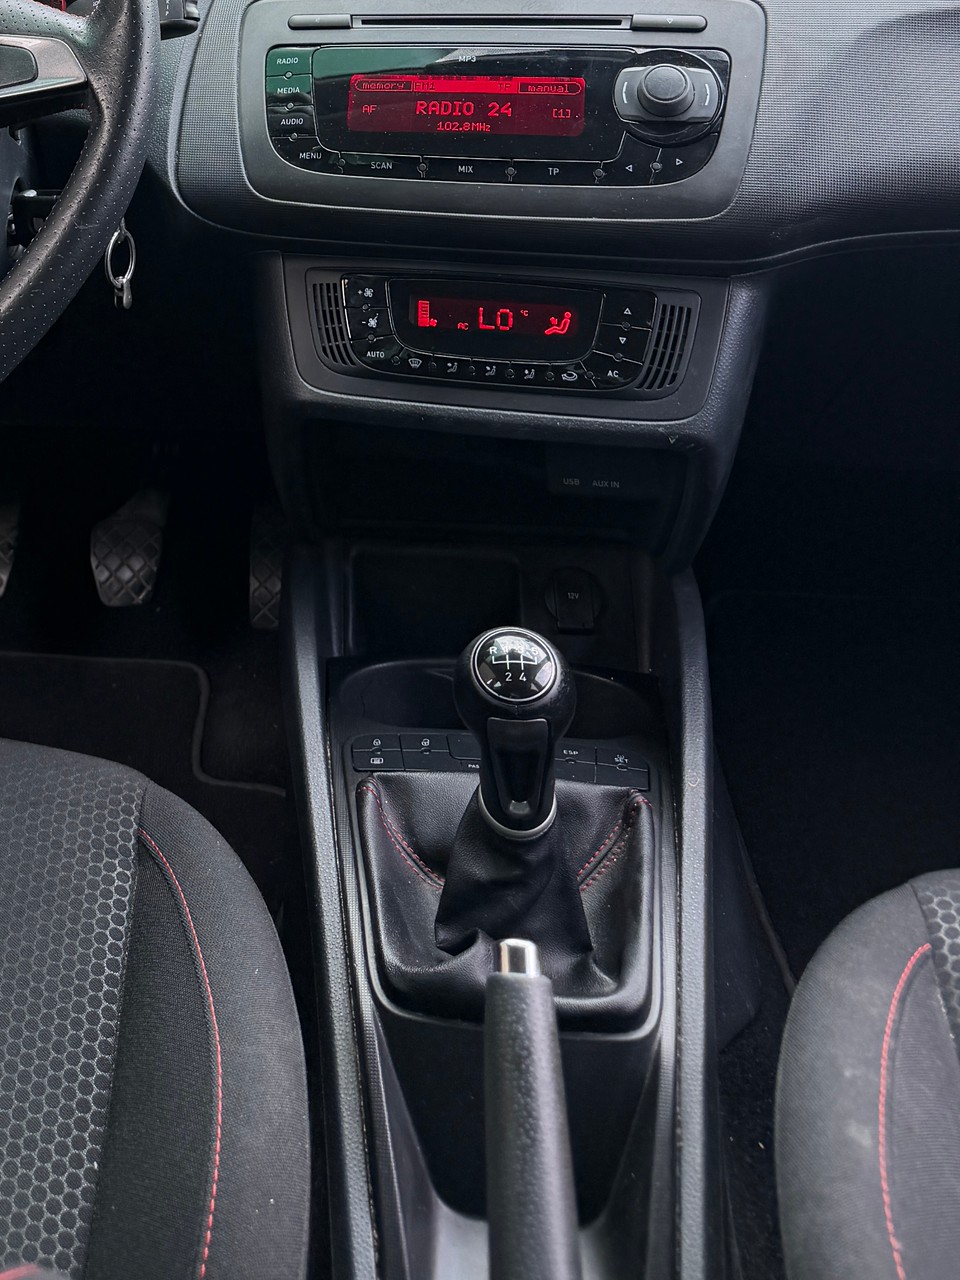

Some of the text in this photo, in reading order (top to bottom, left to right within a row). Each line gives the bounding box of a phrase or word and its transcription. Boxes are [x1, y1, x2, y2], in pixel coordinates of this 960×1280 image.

[276, 57, 299, 65] RADIO
[458, 55, 477, 63] MP3
[277, 86, 300, 94] MEDIA
[361, 81, 405, 90] memory
[414, 82, 436, 91] FM1
[497, 83, 512, 91] TP
[527, 83, 569, 93] manual
[362, 104, 377, 113] AF
[416, 100, 512, 117] RADIO 24
[280, 117, 304, 125] AUDIO
[299, 152, 322, 160] MENU
[370, 161, 393, 170] SCAN
[458, 165, 474, 174] MIX
[547, 167, 560, 176] TP
[457, 322, 469, 330] AC
[478, 307, 514, 331] LO
[366, 351, 385, 359] AUTO
[607, 370, 619, 378] AC
[563, 478, 580, 486] USB
[592, 480, 609, 488] AUX
[567, 592, 580, 600] 12V
[489, 646, 498, 655] R
[531, 646, 539, 655] 5
[504, 671, 513, 682] 2
[519, 671, 527, 682] 4
